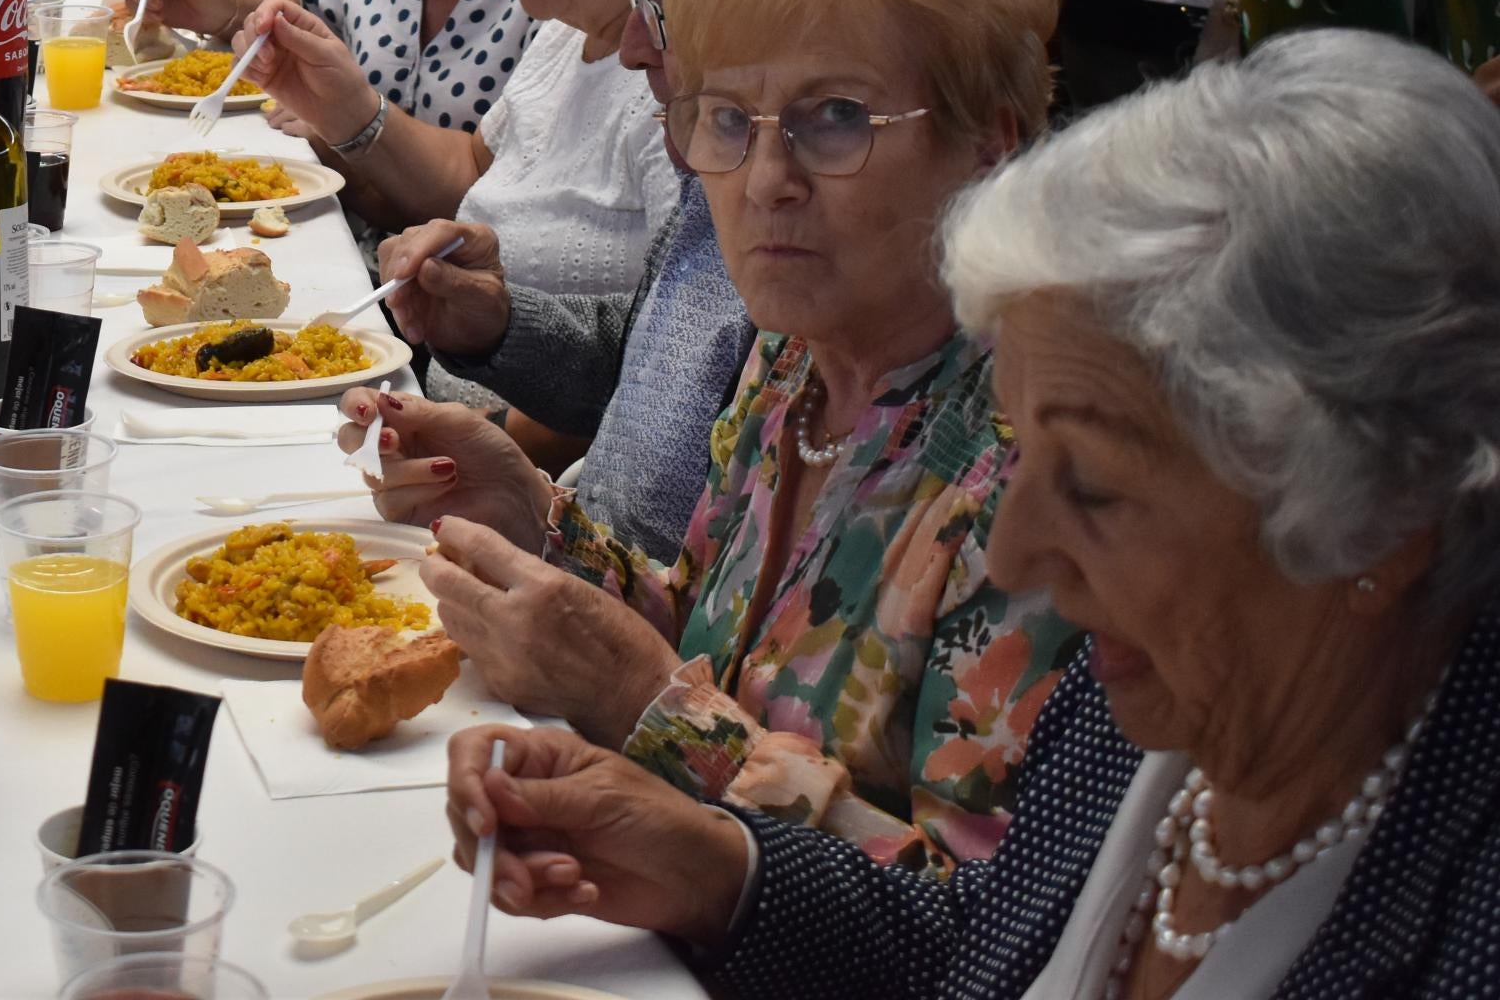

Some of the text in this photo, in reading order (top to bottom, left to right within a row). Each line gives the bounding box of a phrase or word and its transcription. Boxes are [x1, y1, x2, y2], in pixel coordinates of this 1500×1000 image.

[4, 47, 28, 62] SABO
[14, 375, 26, 399] mejor
[11, 400, 21, 412] de
[109, 766, 124, 799] mejor
[107, 801, 119, 816] de
